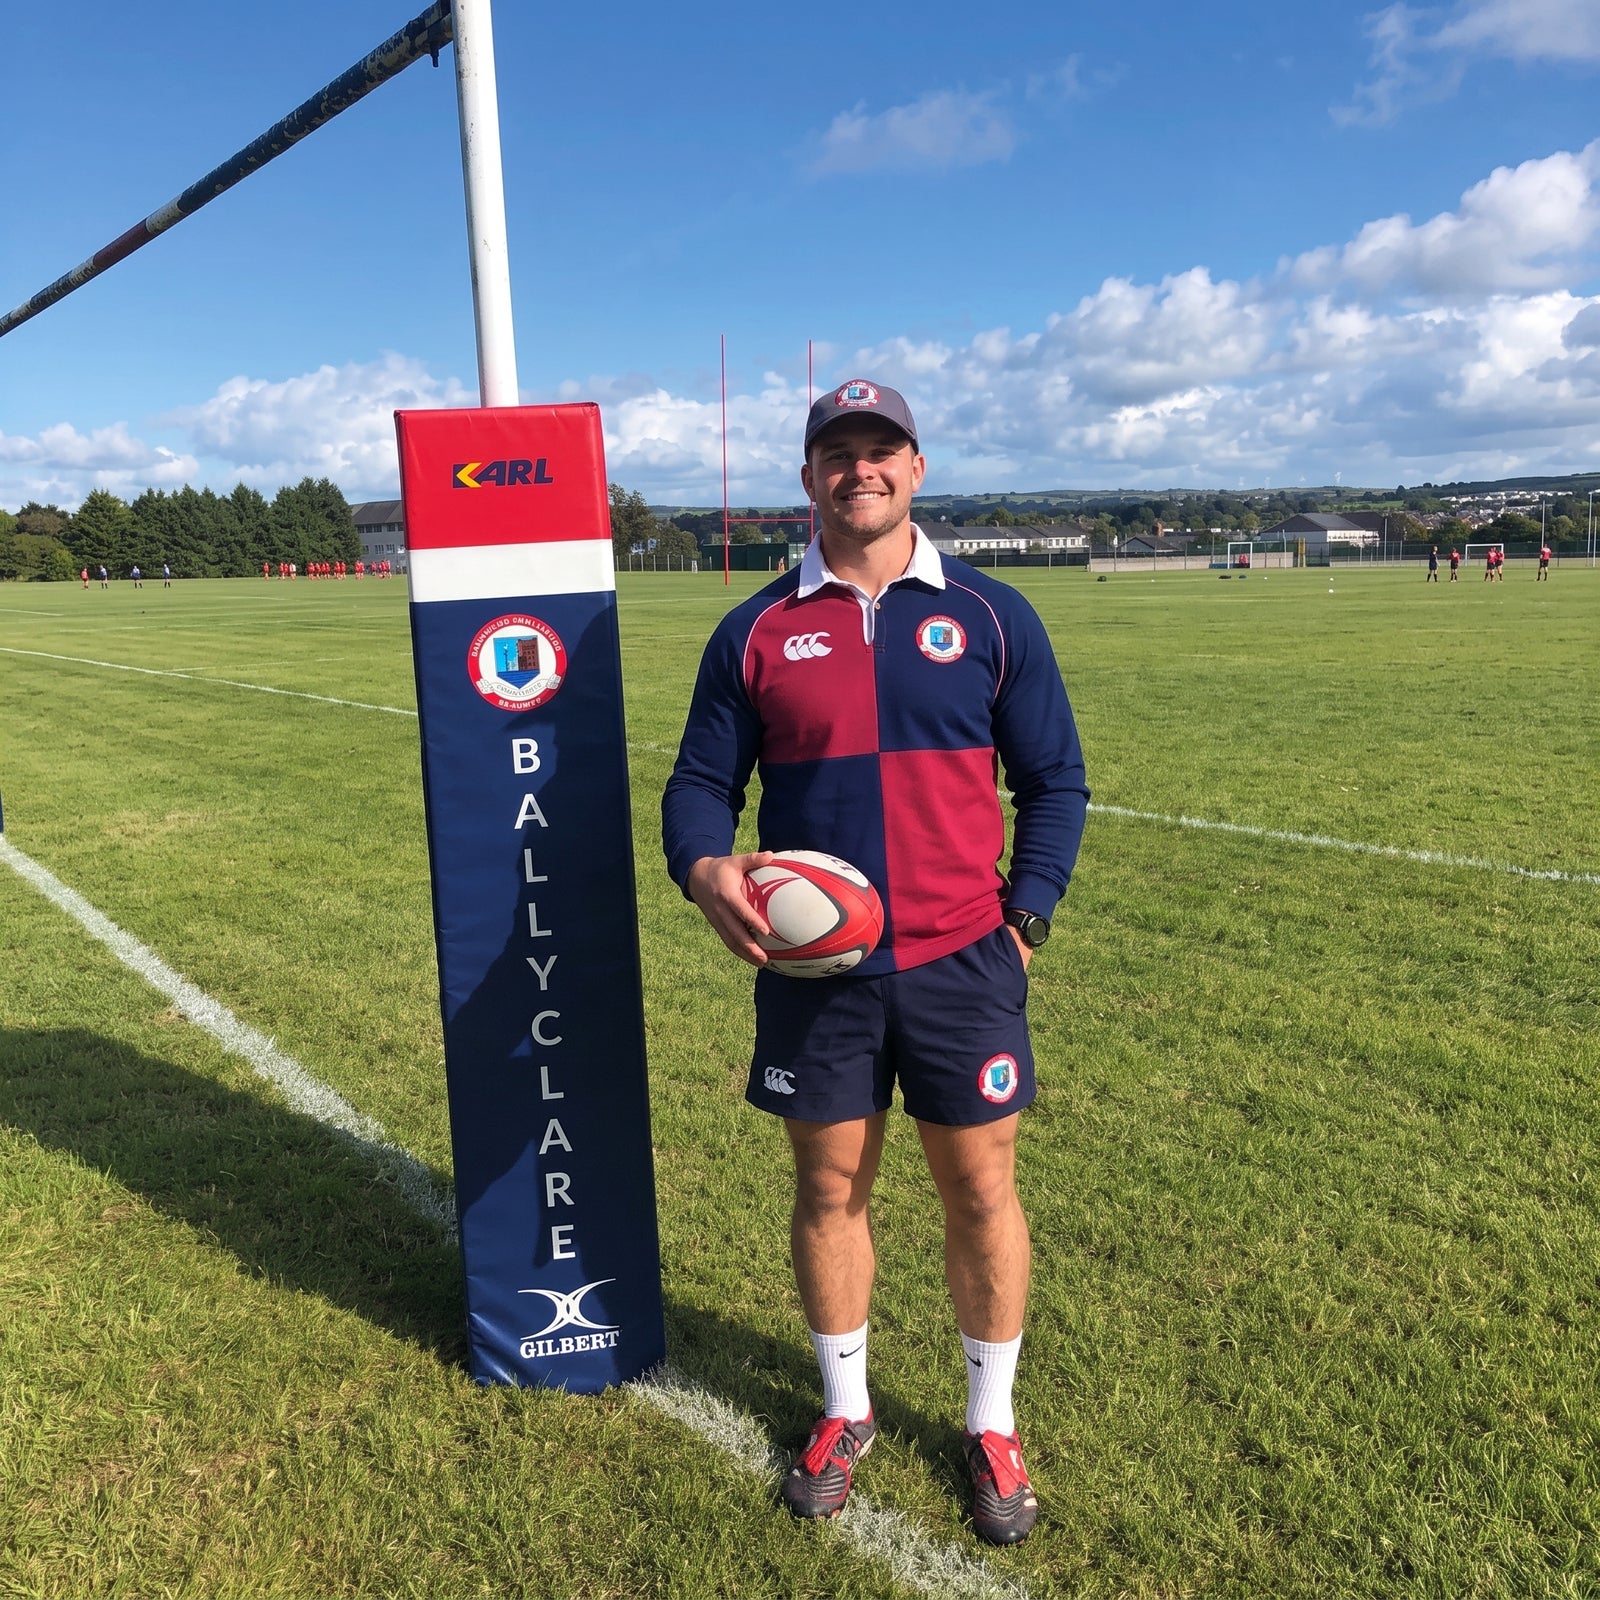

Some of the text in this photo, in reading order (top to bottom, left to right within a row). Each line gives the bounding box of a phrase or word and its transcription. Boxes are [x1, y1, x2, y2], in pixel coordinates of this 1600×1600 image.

[453, 458, 554, 488] KARL
[511, 737, 577, 1261] BALLYCLARE
[519, 1330, 620, 1359] GILBERT
